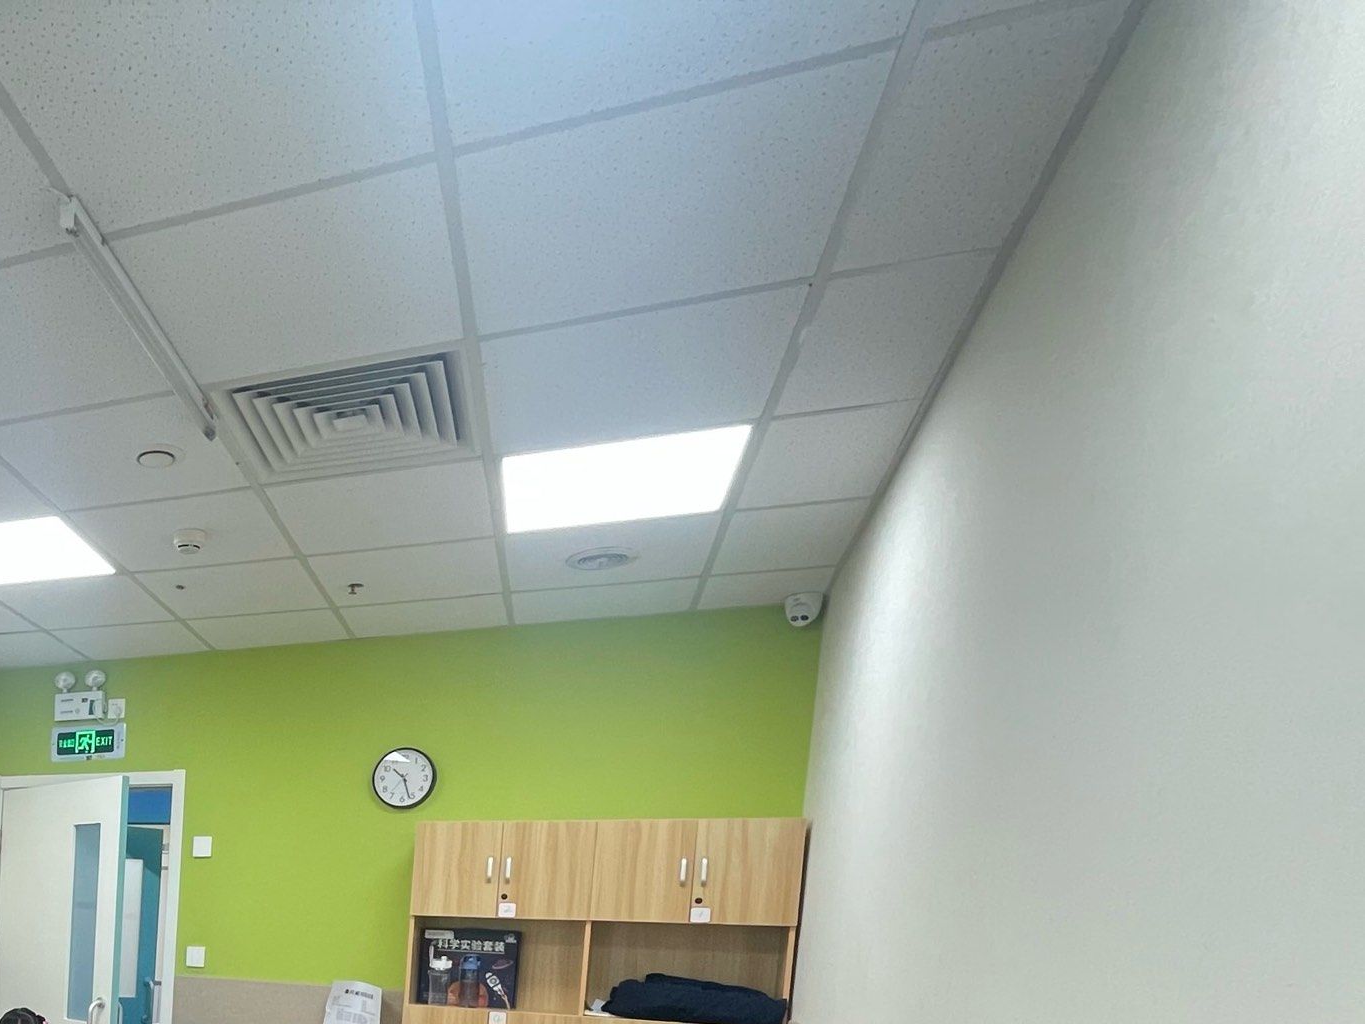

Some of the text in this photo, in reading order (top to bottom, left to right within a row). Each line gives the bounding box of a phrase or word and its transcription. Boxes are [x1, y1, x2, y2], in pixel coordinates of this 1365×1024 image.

[96, 736, 113, 747] EXIT
[420, 764, 426, 772] 2
[437, 938, 505, 953] 科学实验套装
